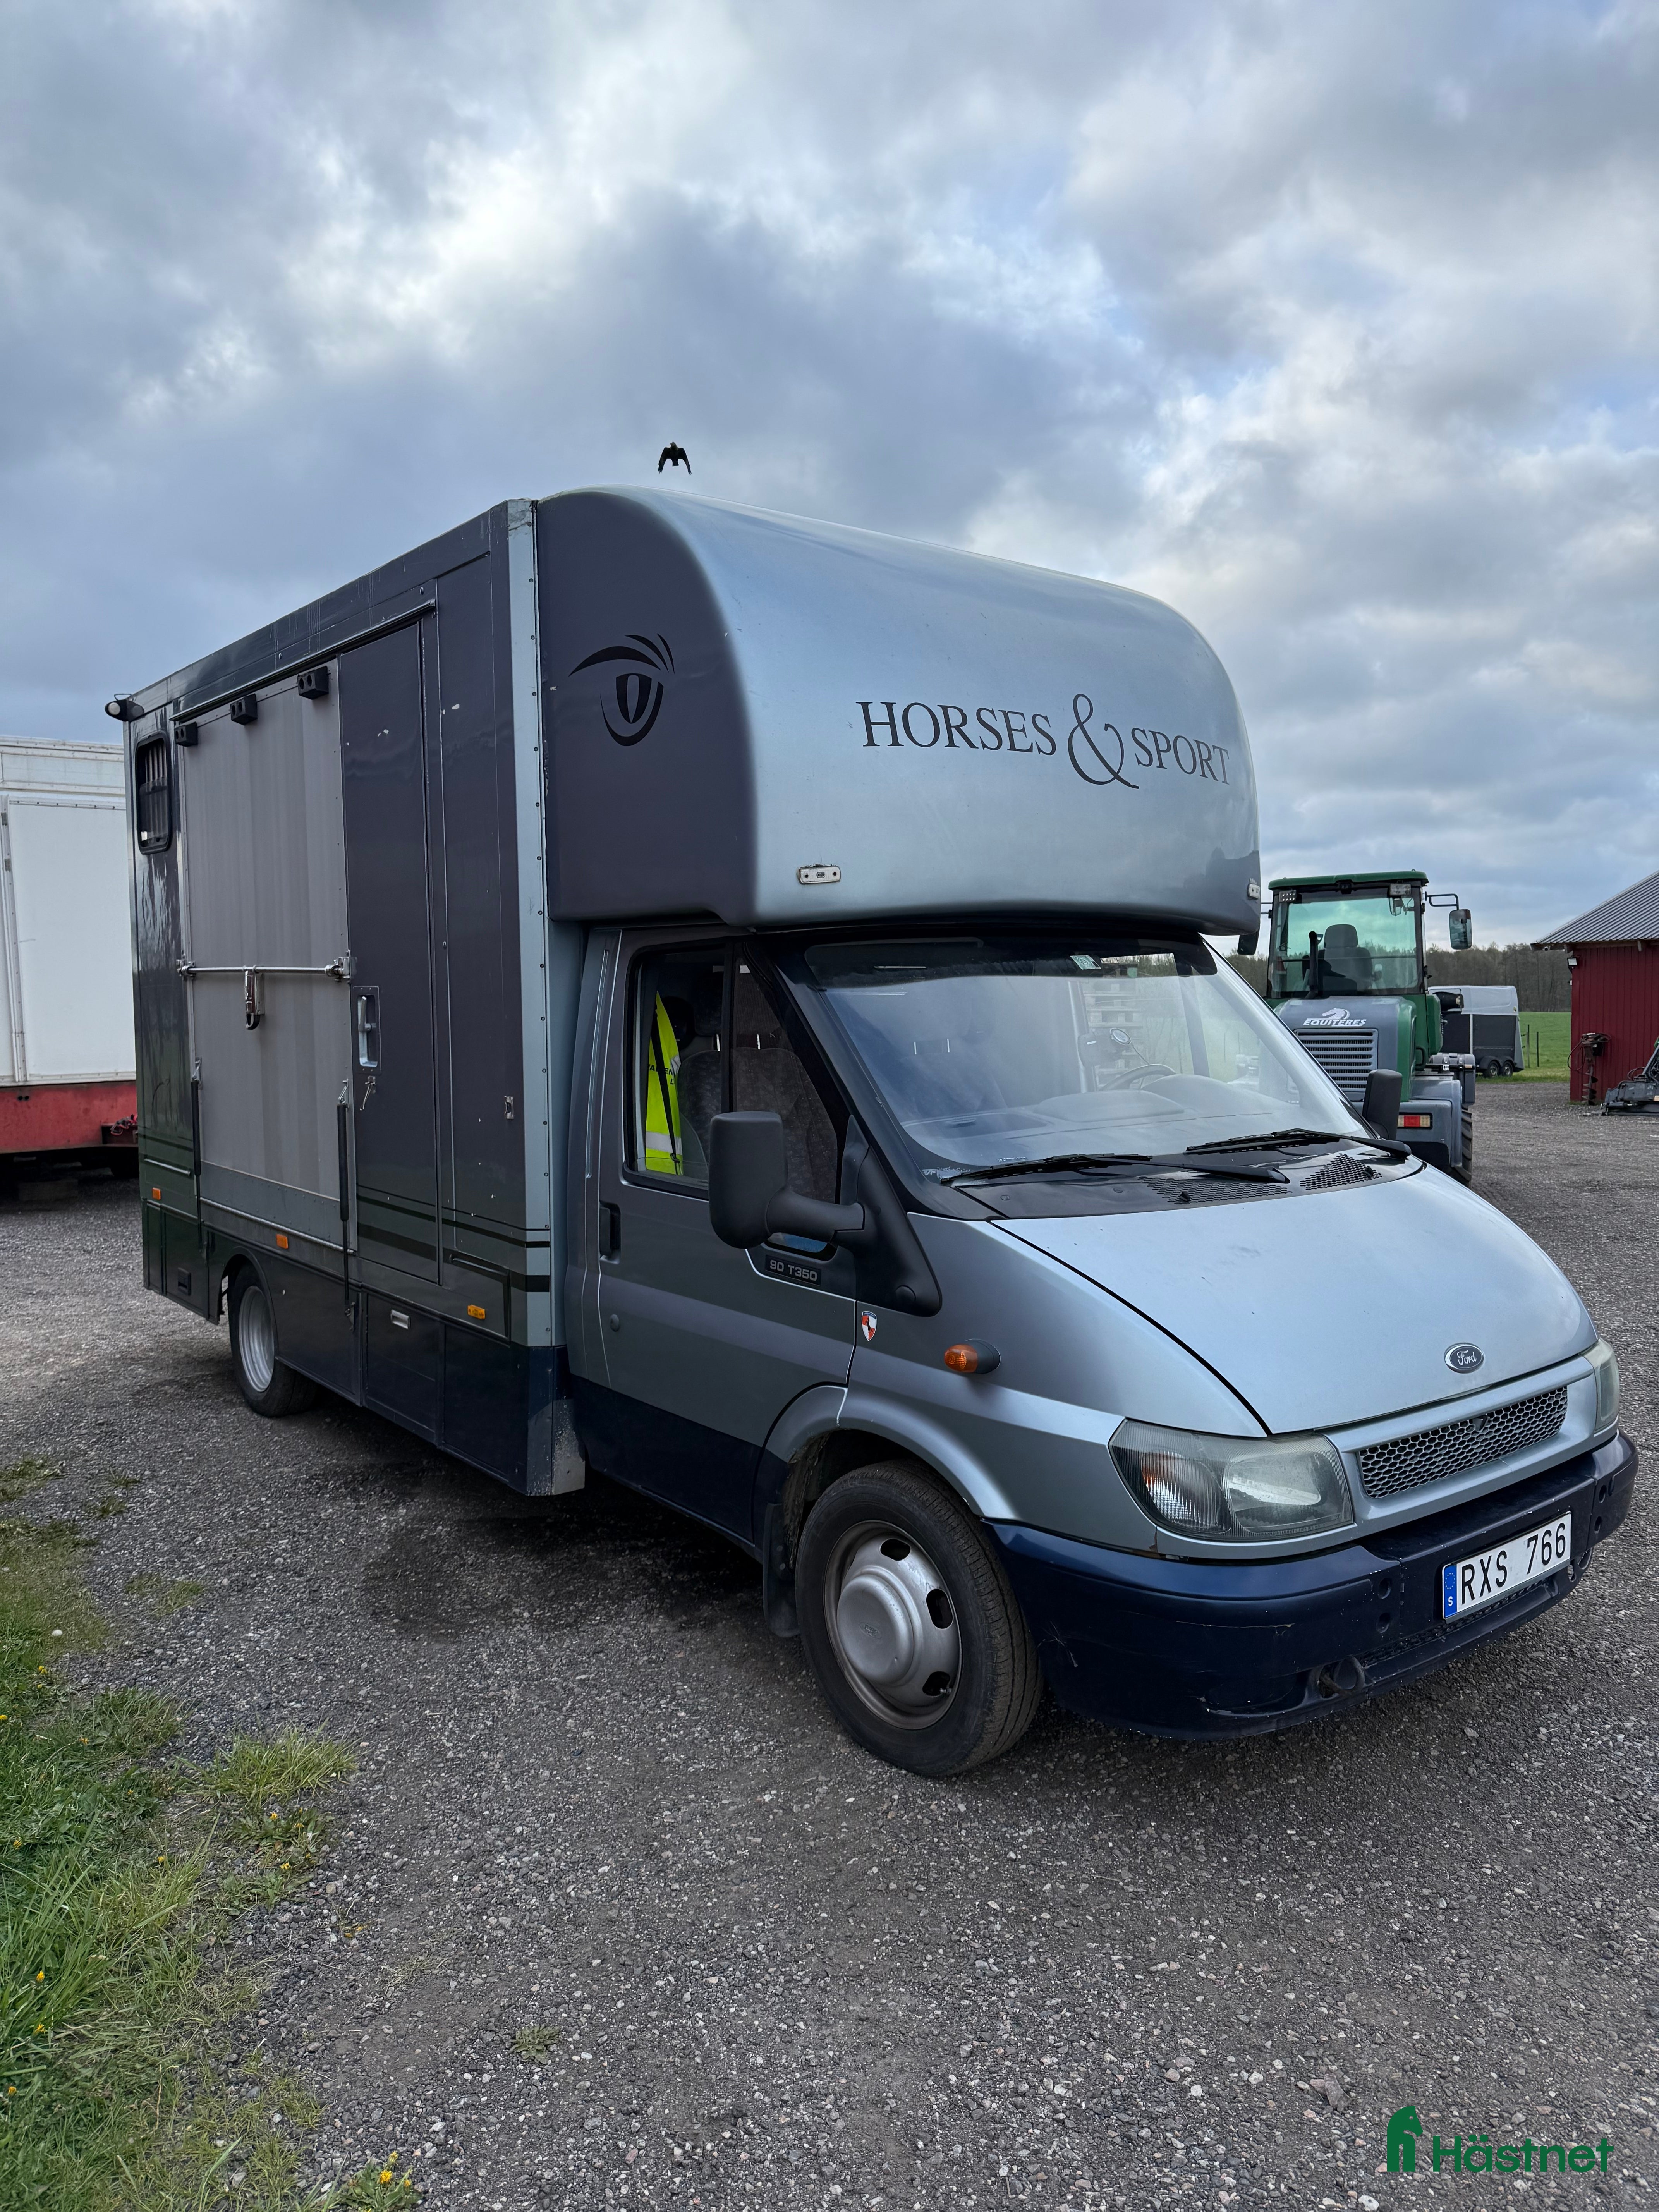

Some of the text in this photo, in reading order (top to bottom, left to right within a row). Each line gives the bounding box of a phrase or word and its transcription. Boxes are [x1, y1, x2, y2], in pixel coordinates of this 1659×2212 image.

[856, 693, 1230, 790] HORSES & SPORT
[770, 1260, 817, 1281] 90 T350
[1457, 1350, 1477, 1365] Ford
[1462, 1522, 1566, 1605] RXS 766
[1448, 1595, 1453, 1607] S
